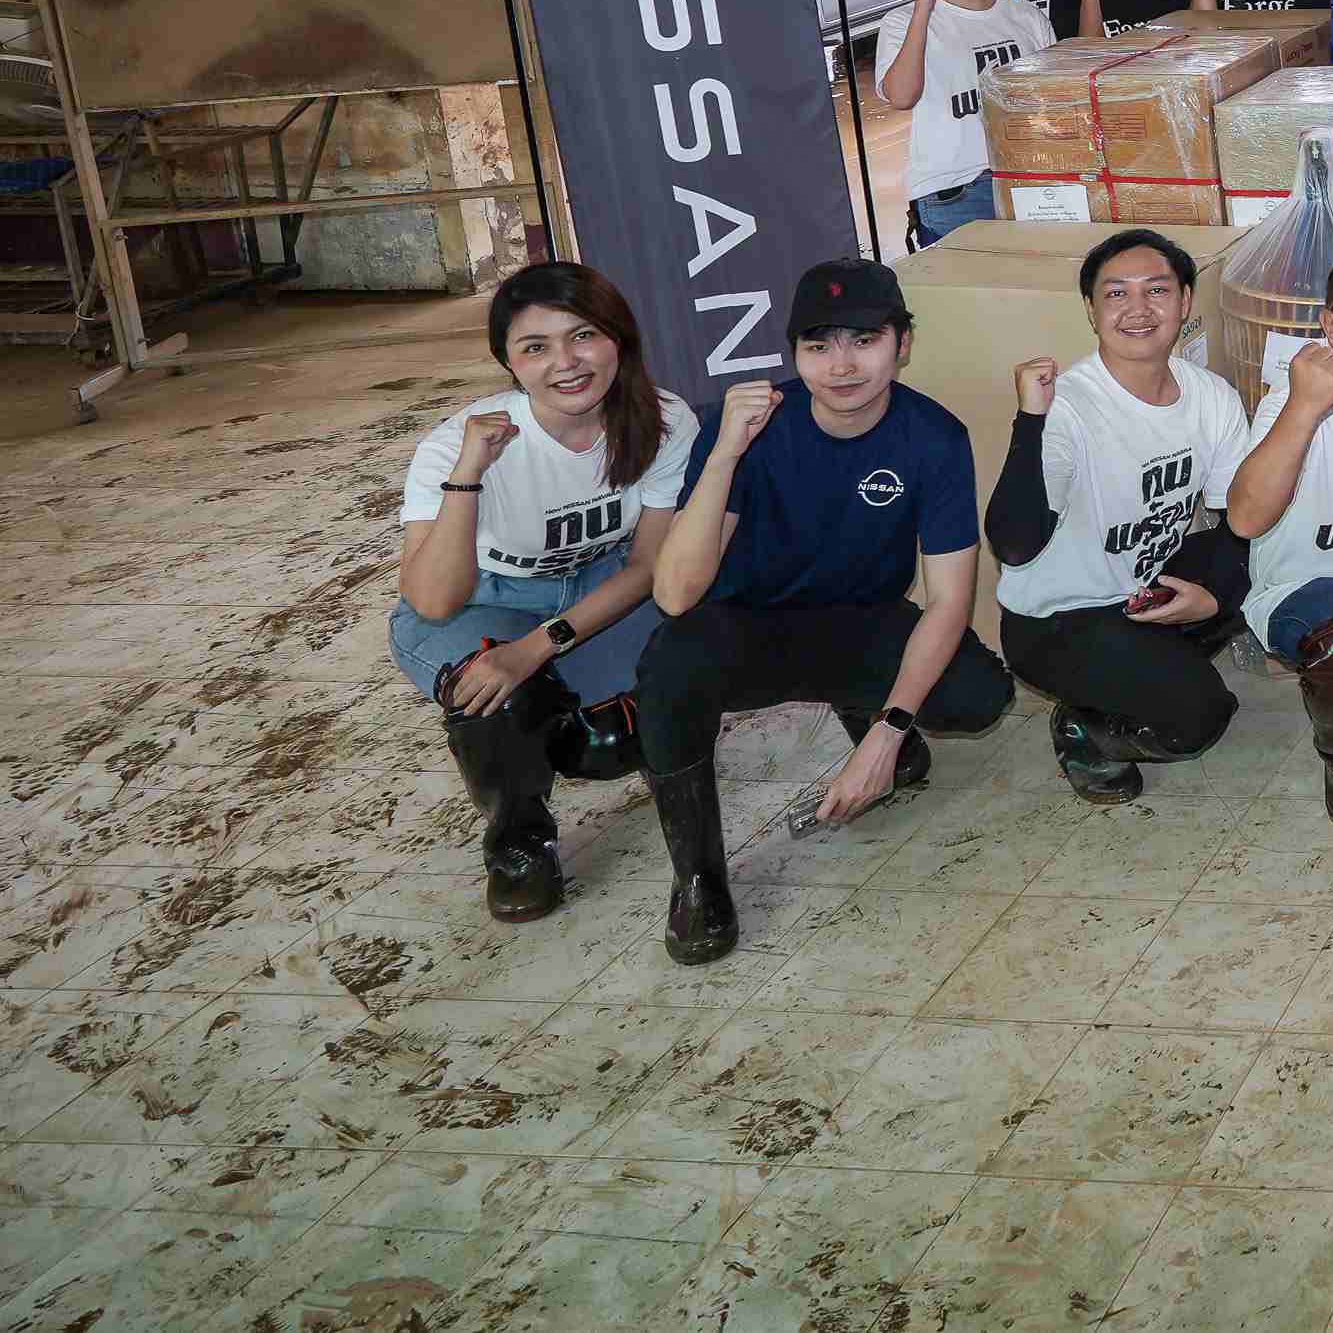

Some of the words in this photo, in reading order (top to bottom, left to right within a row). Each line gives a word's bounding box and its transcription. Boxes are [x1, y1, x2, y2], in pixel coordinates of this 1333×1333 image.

[857, 483, 904, 493] NISSAN
[1142, 455, 1192, 505] ทน
[544, 497, 622, 551] ทน
